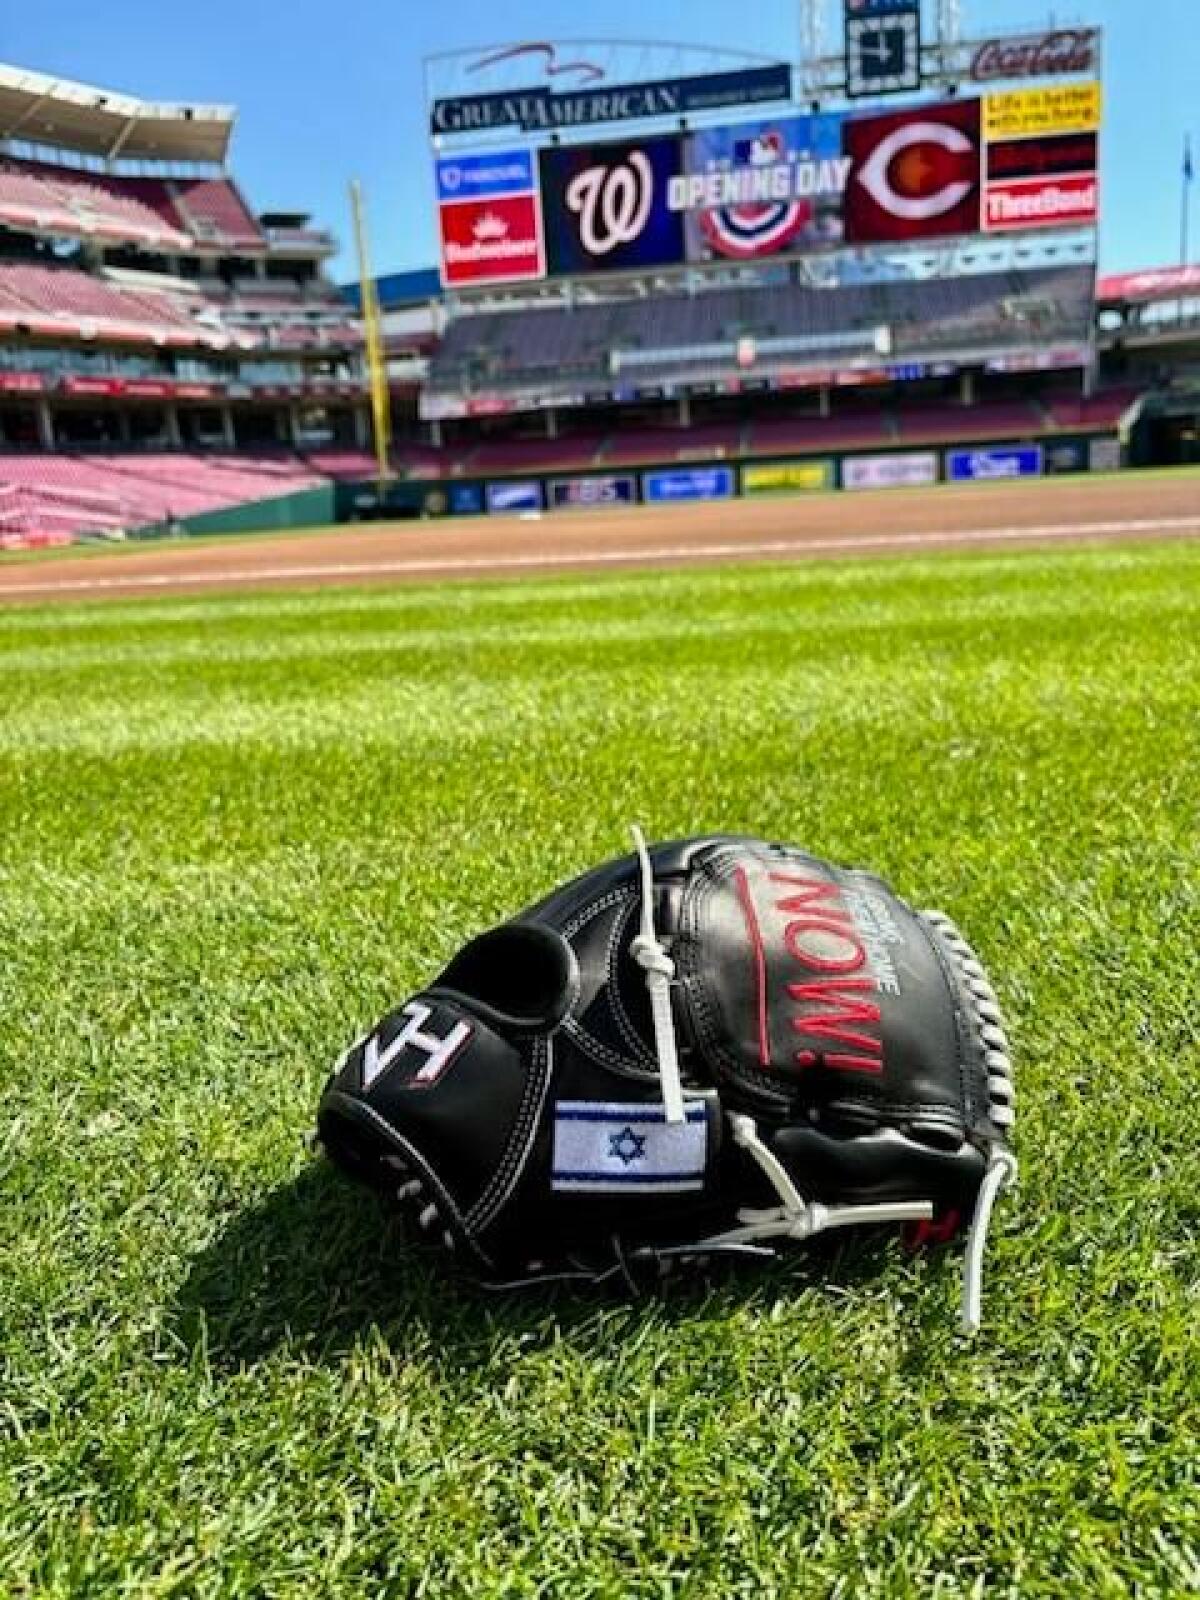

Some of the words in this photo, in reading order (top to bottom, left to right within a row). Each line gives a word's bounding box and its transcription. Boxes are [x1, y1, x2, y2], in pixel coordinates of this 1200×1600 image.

[566, 150, 654, 256] W
[667, 162, 790, 211] OPENING
[796, 154, 853, 195] DAY
